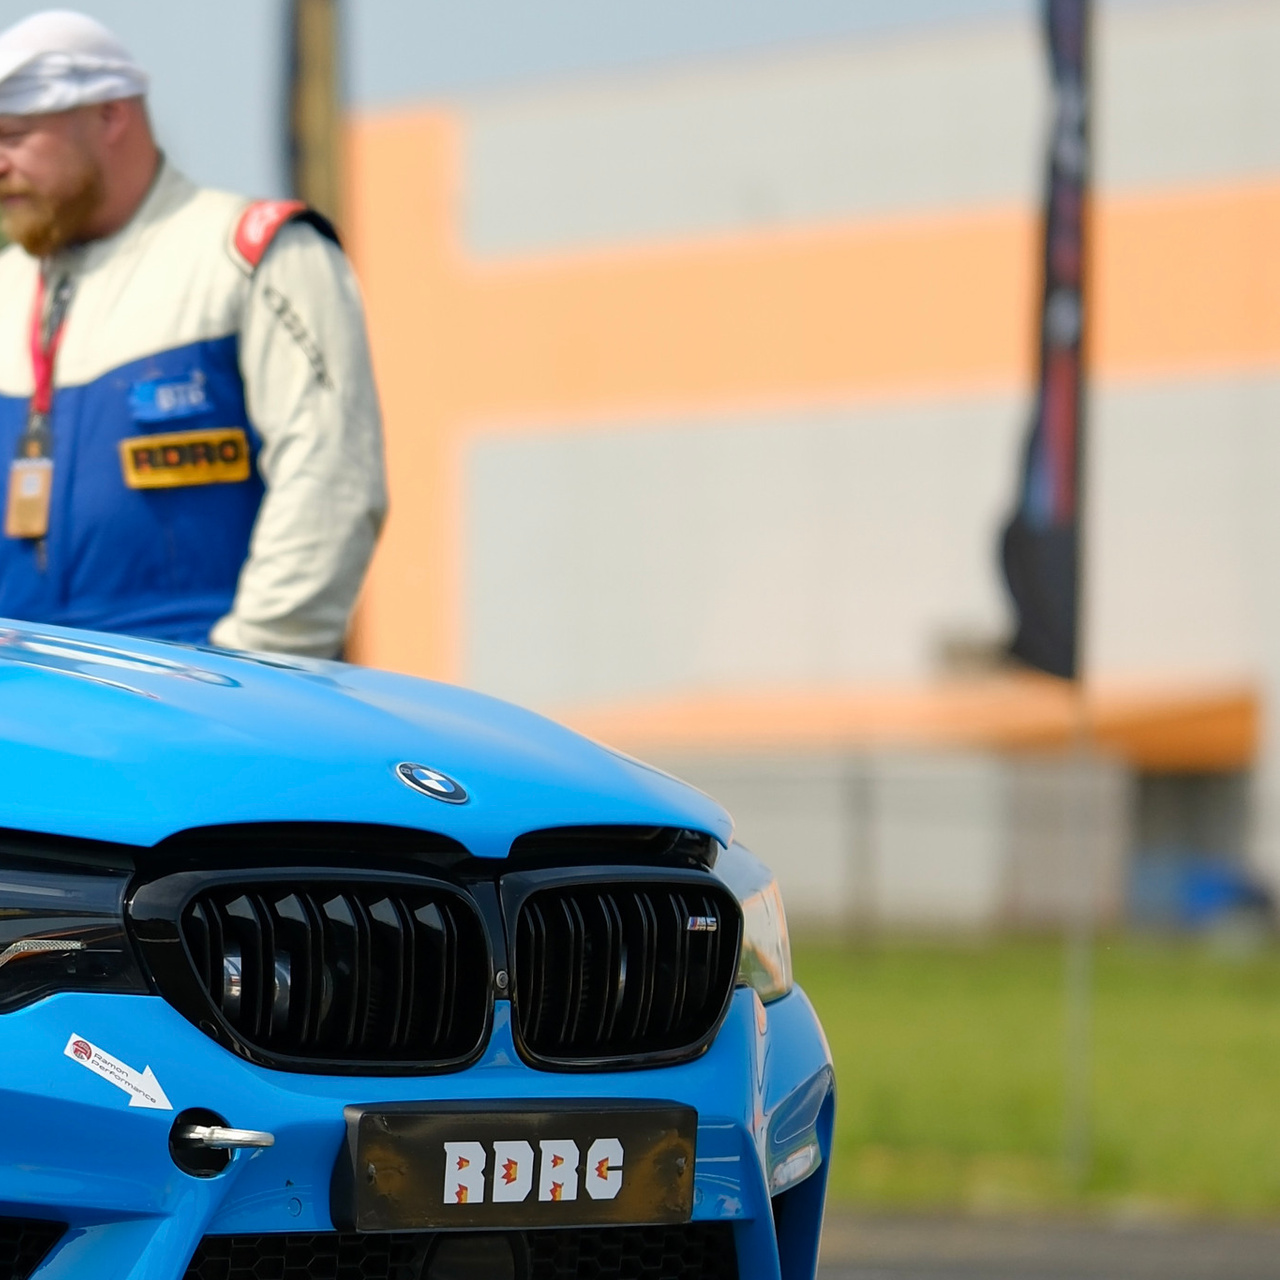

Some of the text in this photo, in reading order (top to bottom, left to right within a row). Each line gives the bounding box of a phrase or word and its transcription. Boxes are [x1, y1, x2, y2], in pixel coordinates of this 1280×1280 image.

[91, 1059, 157, 1104] Performance
[93, 1052, 129, 1078] Ramon
[443, 1138, 625, 1204] RDRC
